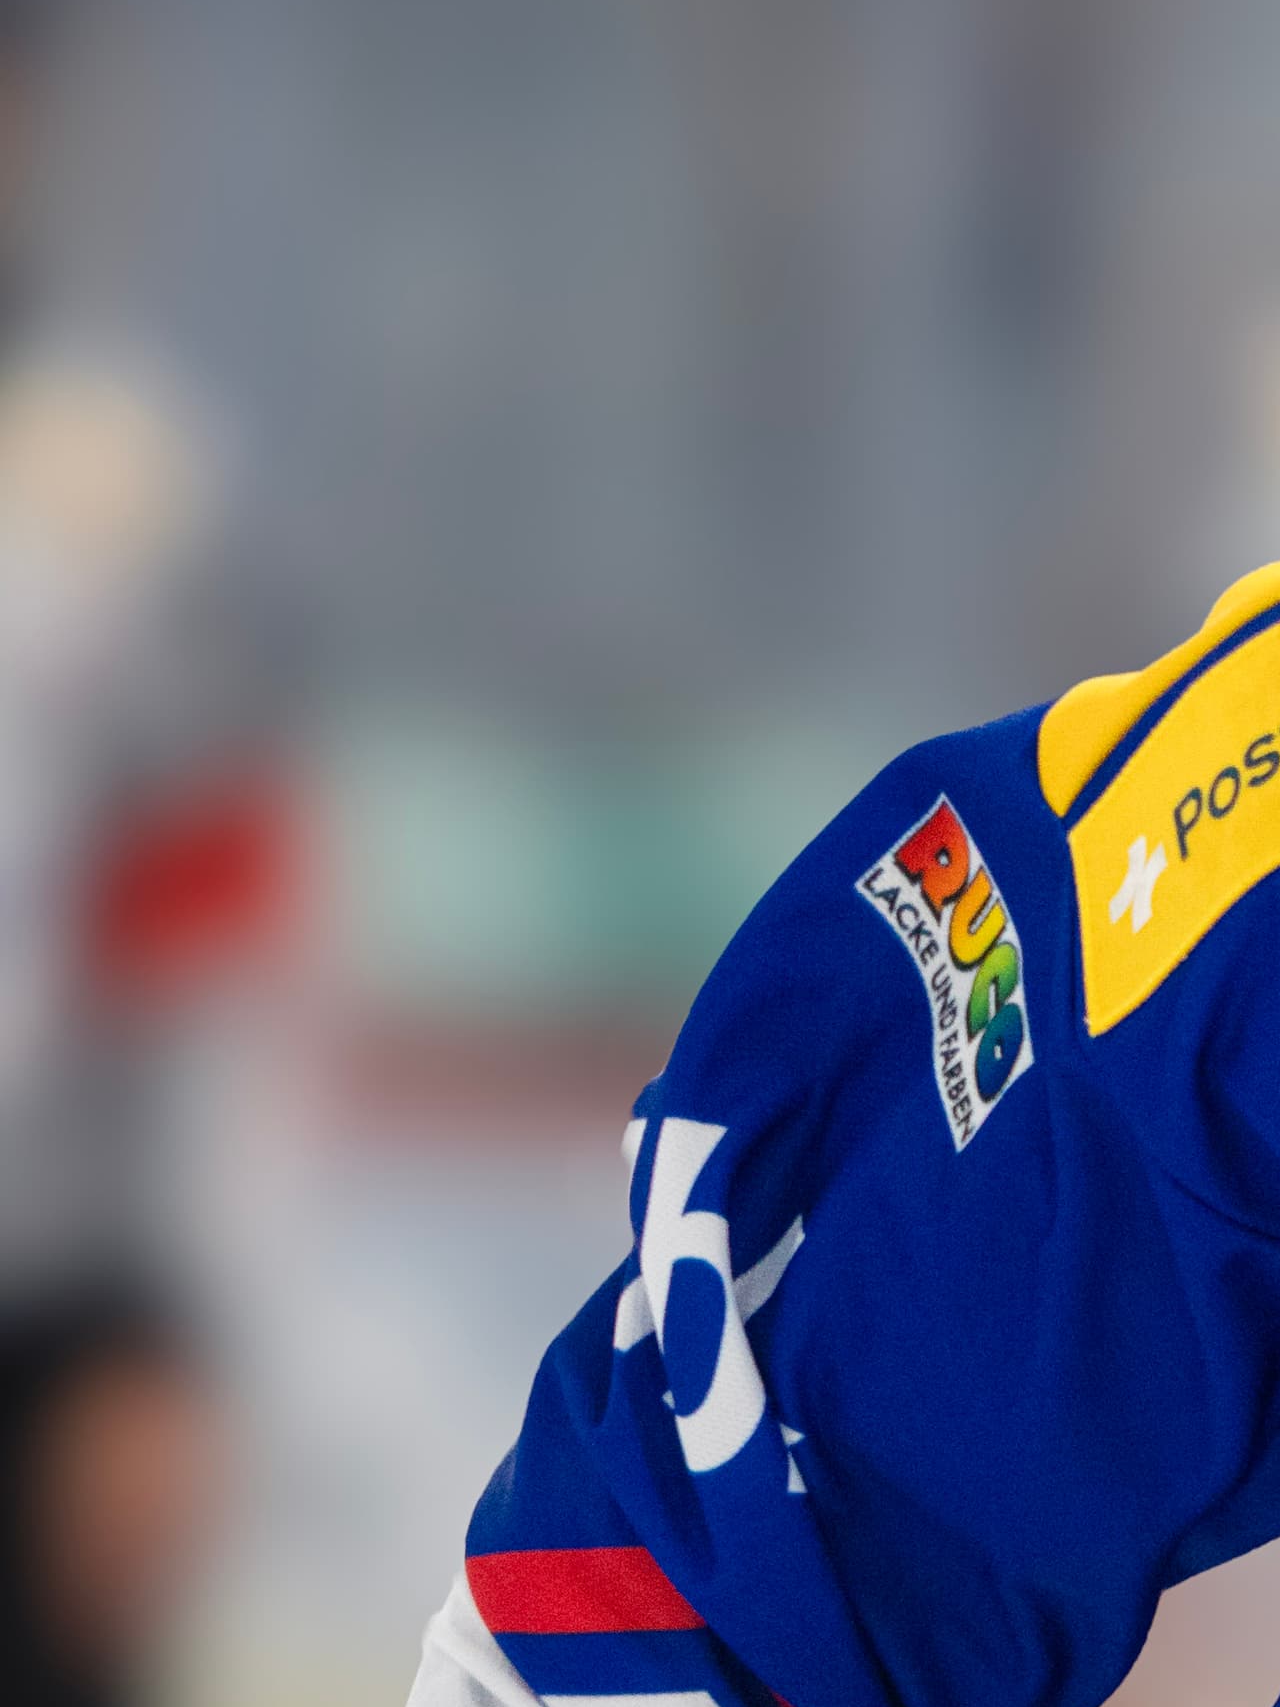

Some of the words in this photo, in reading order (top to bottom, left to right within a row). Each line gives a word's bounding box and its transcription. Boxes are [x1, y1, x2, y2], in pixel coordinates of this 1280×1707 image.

[863, 867, 939, 966] LACKE
[894, 802, 1024, 1105] RUCO
[930, 962, 958, 1031] UND
[938, 1033, 975, 1142] FARBEN
